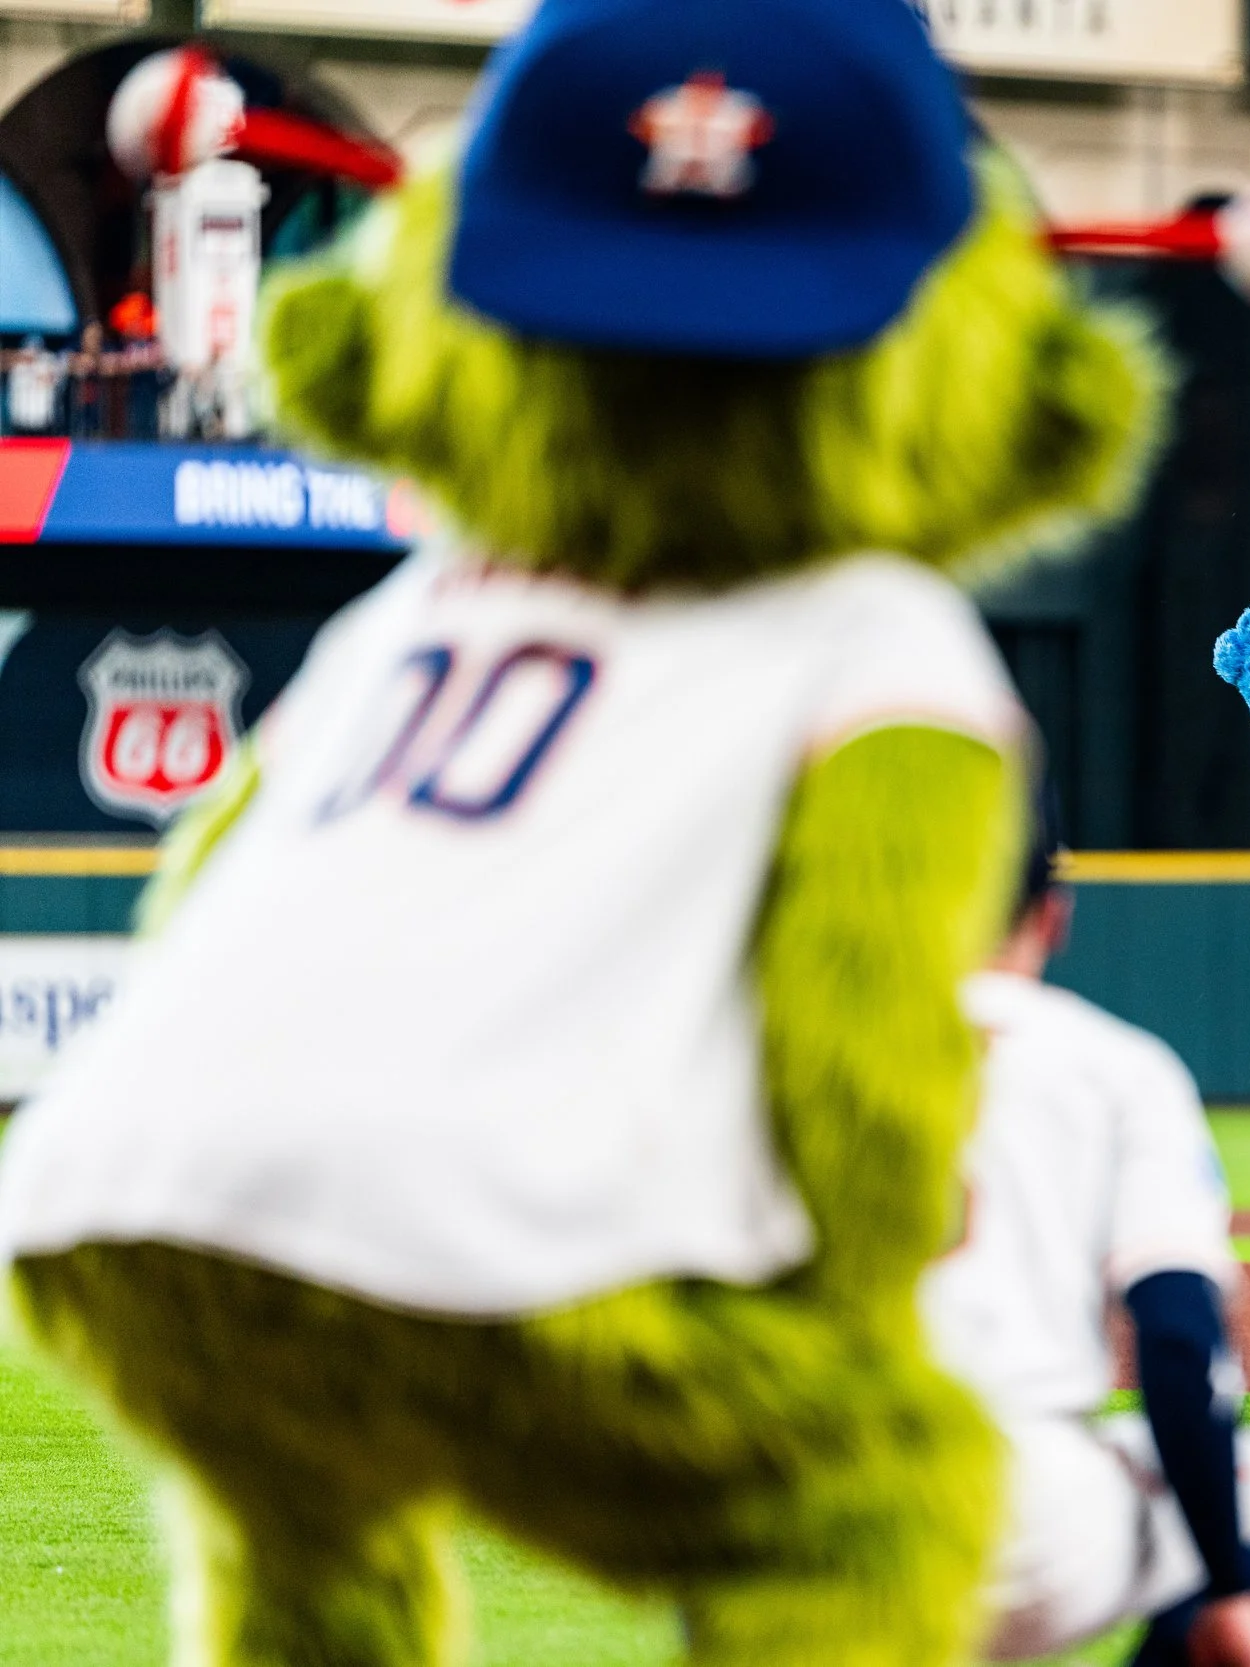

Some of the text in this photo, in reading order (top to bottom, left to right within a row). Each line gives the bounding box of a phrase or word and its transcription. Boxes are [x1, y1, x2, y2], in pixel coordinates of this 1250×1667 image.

[174, 460, 302, 528] BRING
[306, 469, 379, 531] THE
[114, 710, 209, 784] 66
[0, 976, 116, 1053] spe
